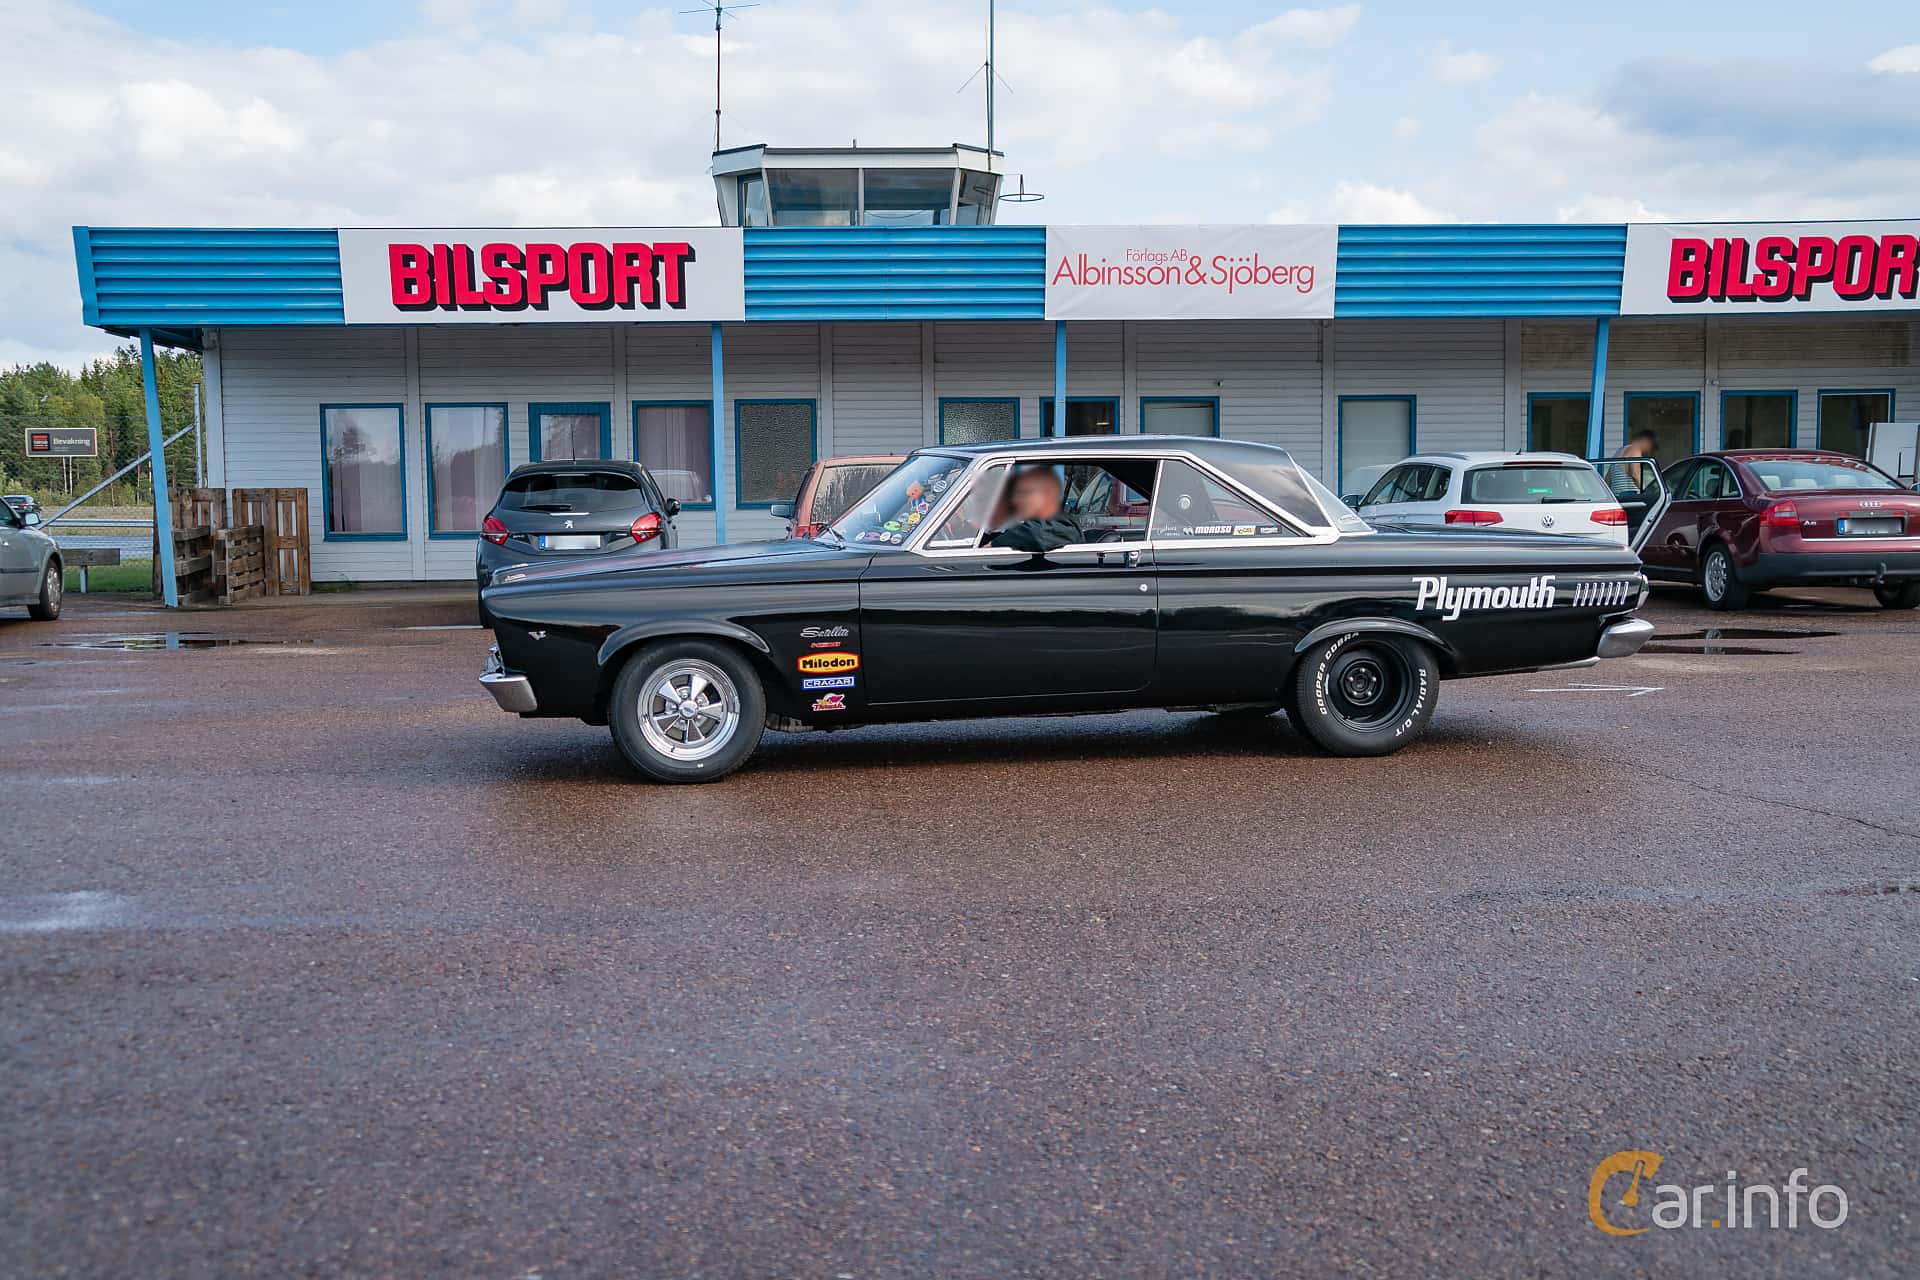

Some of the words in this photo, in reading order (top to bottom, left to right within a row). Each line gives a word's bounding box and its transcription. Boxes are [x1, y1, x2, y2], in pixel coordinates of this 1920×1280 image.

[388, 242, 697, 312] BILSPORT
[1126, 249, 1168, 265] Förlags
[1171, 249, 1188, 262] AB
[1667, 234, 1920, 303] BILSPOR
[1411, 575, 1556, 622] Plymouth
[802, 658, 855, 669] Milodon
[806, 679, 851, 687] CRAGAR
[1315, 662, 1328, 715] COOPER
[1325, 632, 1359, 660] COBRA
[1411, 668, 1427, 716] RADIAL
